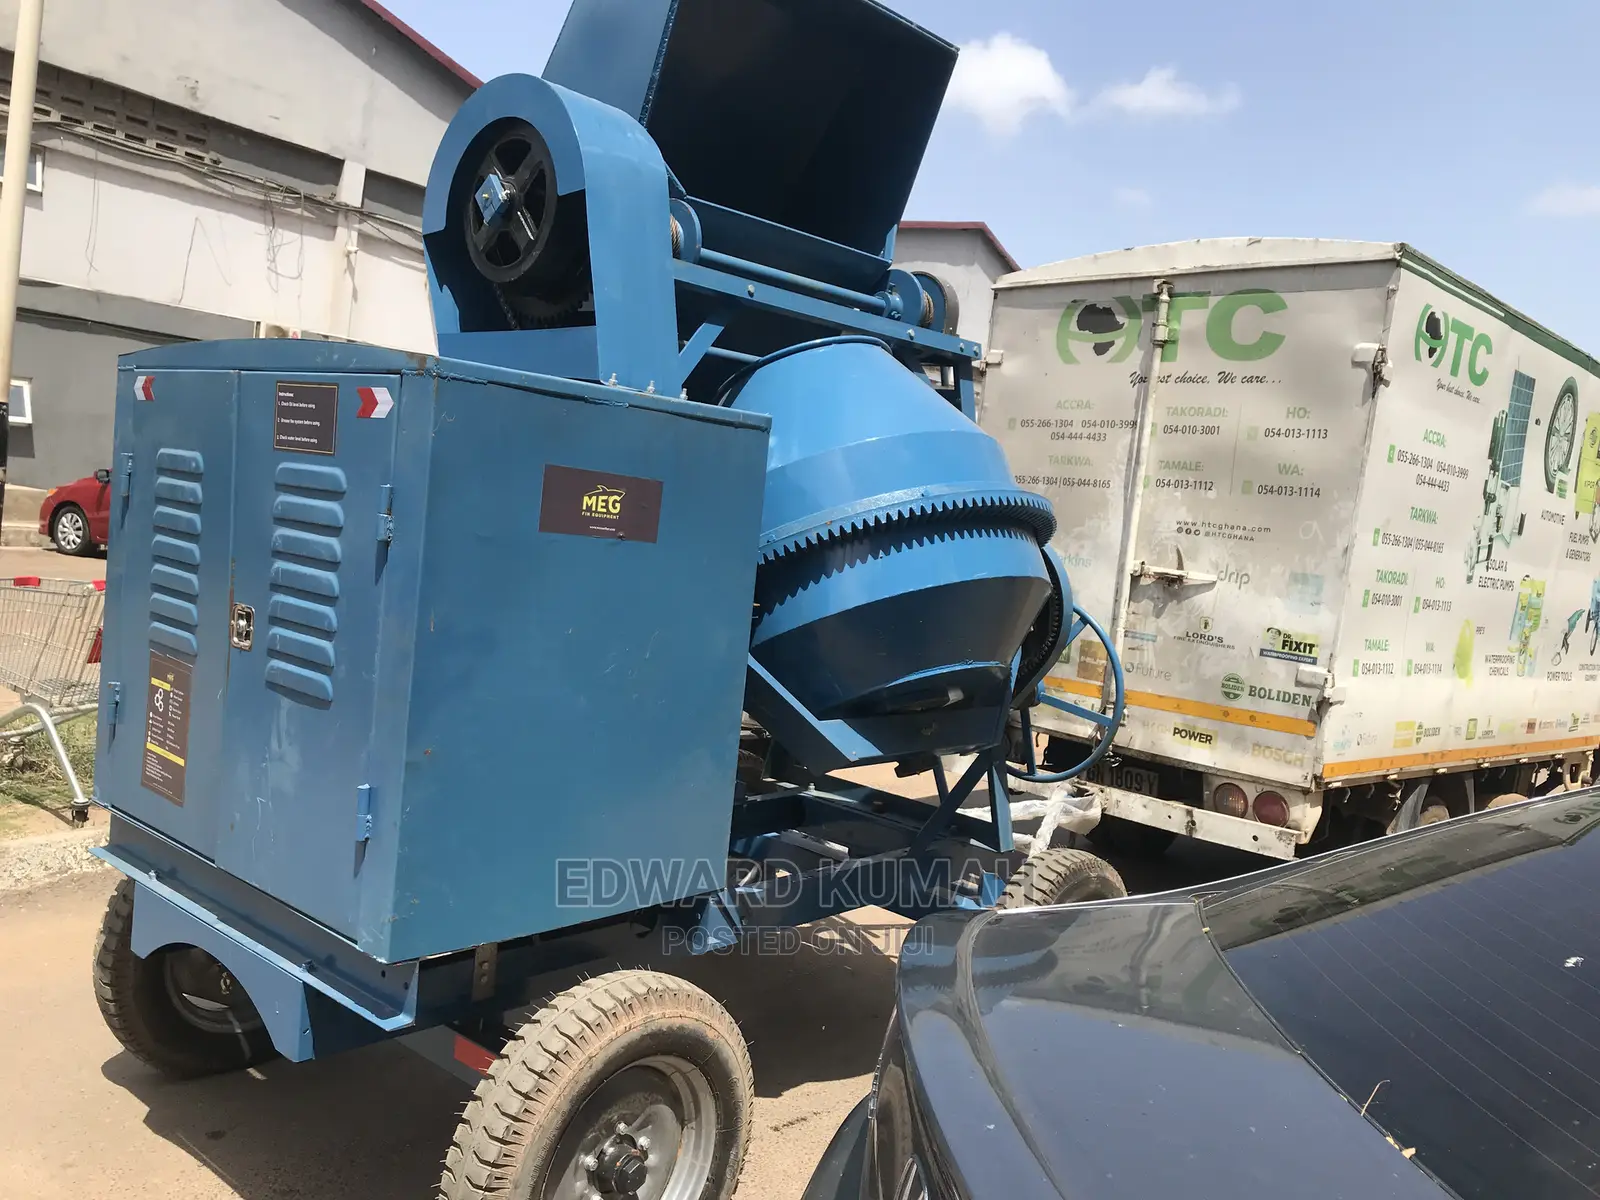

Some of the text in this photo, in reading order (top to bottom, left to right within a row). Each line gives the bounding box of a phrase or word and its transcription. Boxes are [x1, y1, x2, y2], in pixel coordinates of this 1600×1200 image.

[1217, 370, 1237, 384] We
[1166, 406, 1229, 418] TAKORADI:
[1285, 406, 1311, 419] HO:
[1020, 419, 1074, 428] 055-266-1304
[1163, 424, 1220, 436] 054-010-3001
[1050, 432, 1107, 442] 054-444-4433
[1264, 427, 1329, 440] 054-013-1113
[1158, 460, 1204, 472] TAMALE:
[1277, 463, 1305, 476] WA:
[1397, 449, 1469, 480] 055-266-1304 054-010-3999
[1155, 478, 1214, 491] 054-013-1112
[1415, 473, 1450, 493] 054-444-4433
[1257, 484, 1321, 498] 054-013-1114
[582, 495, 620, 514] MEG
[1410, 506, 1439, 525] TARKWA:
[1175, 519, 1272, 533] www.htcghana.com
[1203, 530, 1255, 542] @HTCGHANA
[1489, 558, 1504, 572] SOLAR
[1217, 562, 1251, 590] drip
[1478, 576, 1515, 592] ELECTRIC PUMPS
[1371, 592, 1403, 607] 054-010-3001
[1185, 631, 1224, 644] LORD'S
[1281, 639, 1316, 655] FIXIT
[1361, 662, 1394, 676] 054-013-1112
[1248, 685, 1313, 707] BOLIDEN
[1173, 727, 1213, 744] POWER
[1252, 743, 1304, 767] BOSCH
